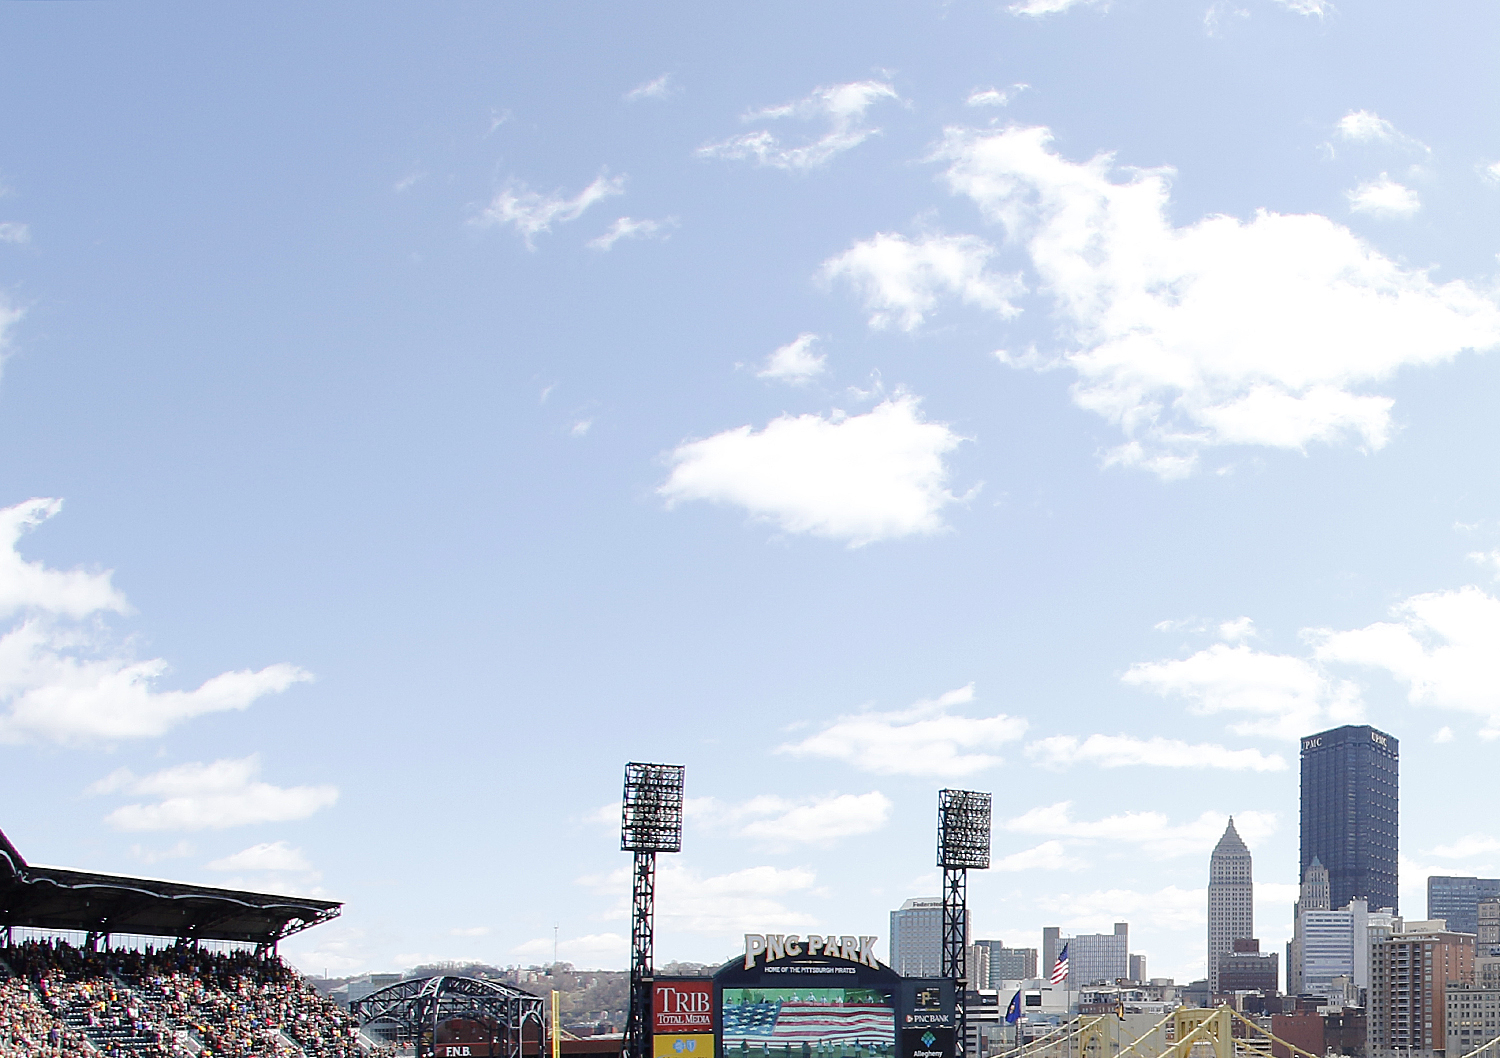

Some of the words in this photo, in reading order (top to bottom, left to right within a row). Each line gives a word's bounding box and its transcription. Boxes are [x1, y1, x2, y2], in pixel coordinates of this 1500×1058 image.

[1371, 731, 1387, 747] UPMC
[744, 933, 802, 971] PNC
[807, 935, 880, 971] PARK
[656, 987, 710, 1013] TRIB
[657, 1014, 684, 1024] TOTAL
[685, 1014, 711, 1024] MEDIA
[446, 1046, 472, 1057] F.N.B.
